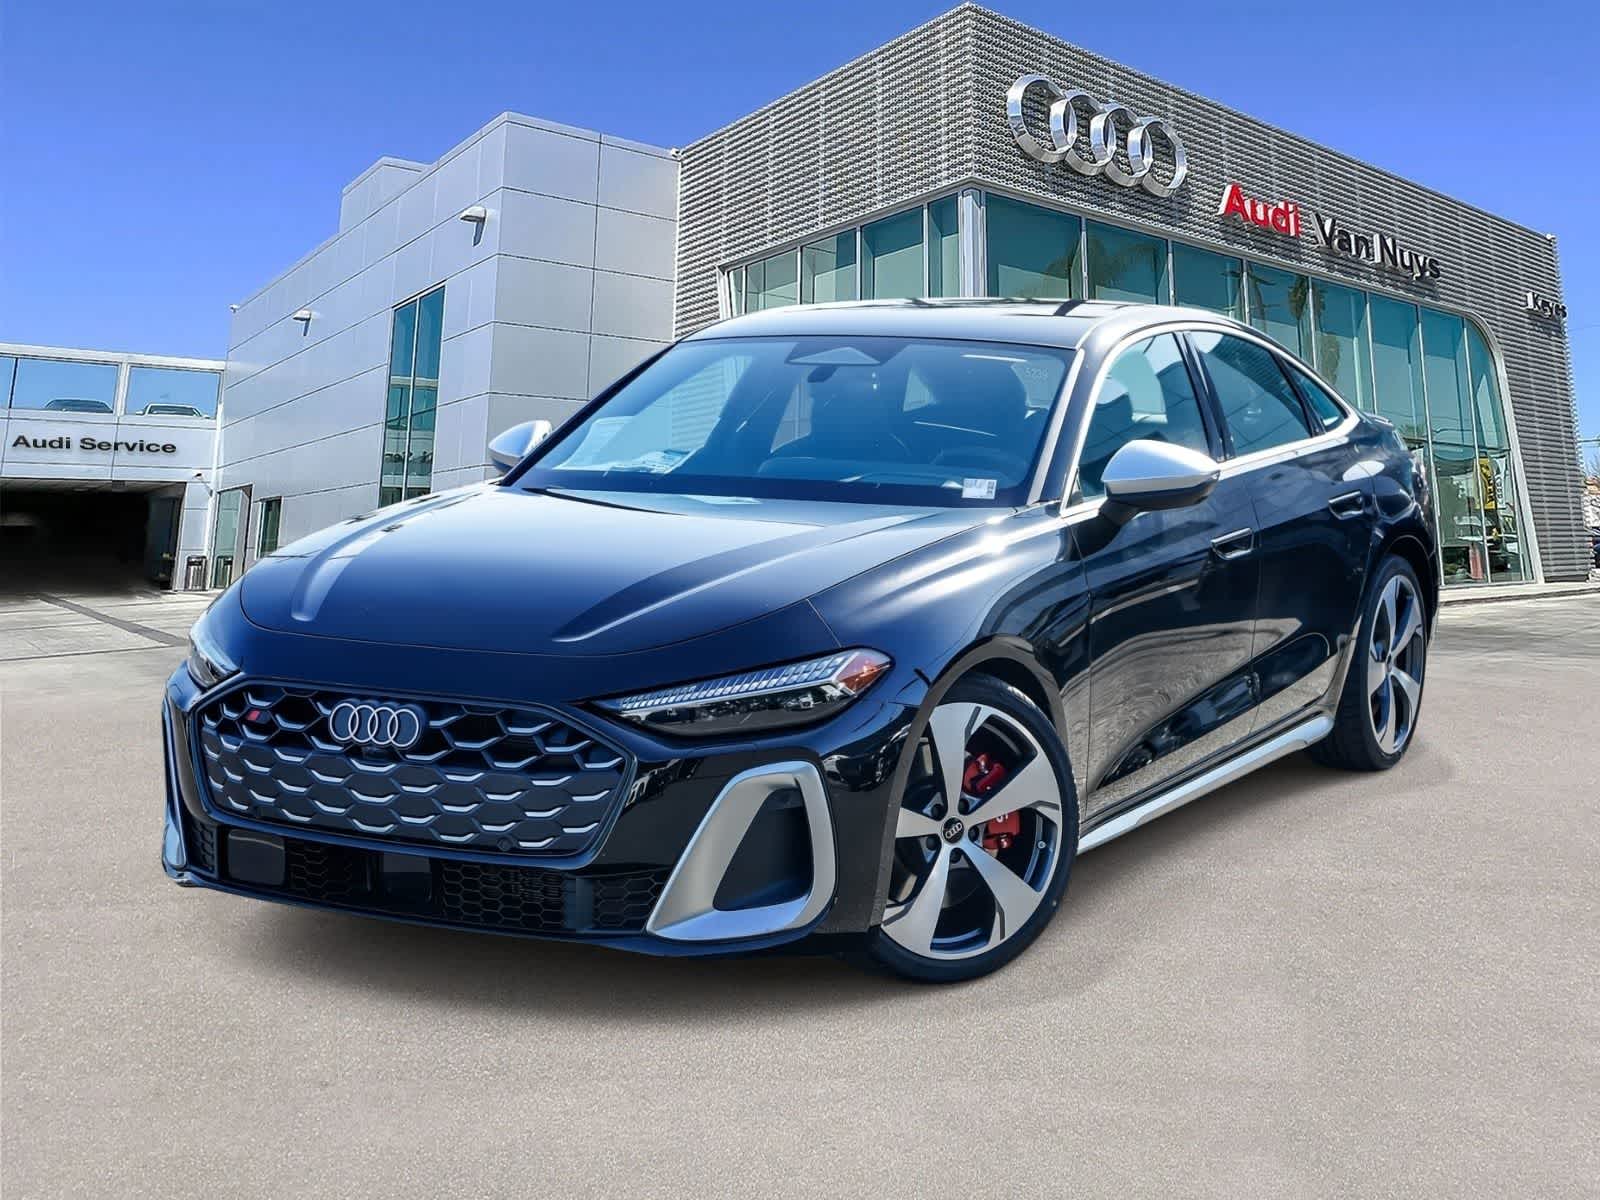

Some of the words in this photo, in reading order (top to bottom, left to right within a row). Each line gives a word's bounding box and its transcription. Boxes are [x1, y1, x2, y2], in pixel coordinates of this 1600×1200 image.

[1217, 182, 1302, 237] Audi
[1311, 212, 1373, 259] Van
[1373, 233, 1442, 279] Nuys
[1527, 292, 1568, 318] Keyes
[12, 434, 71, 450] Audi
[79, 437, 177, 454] Service
